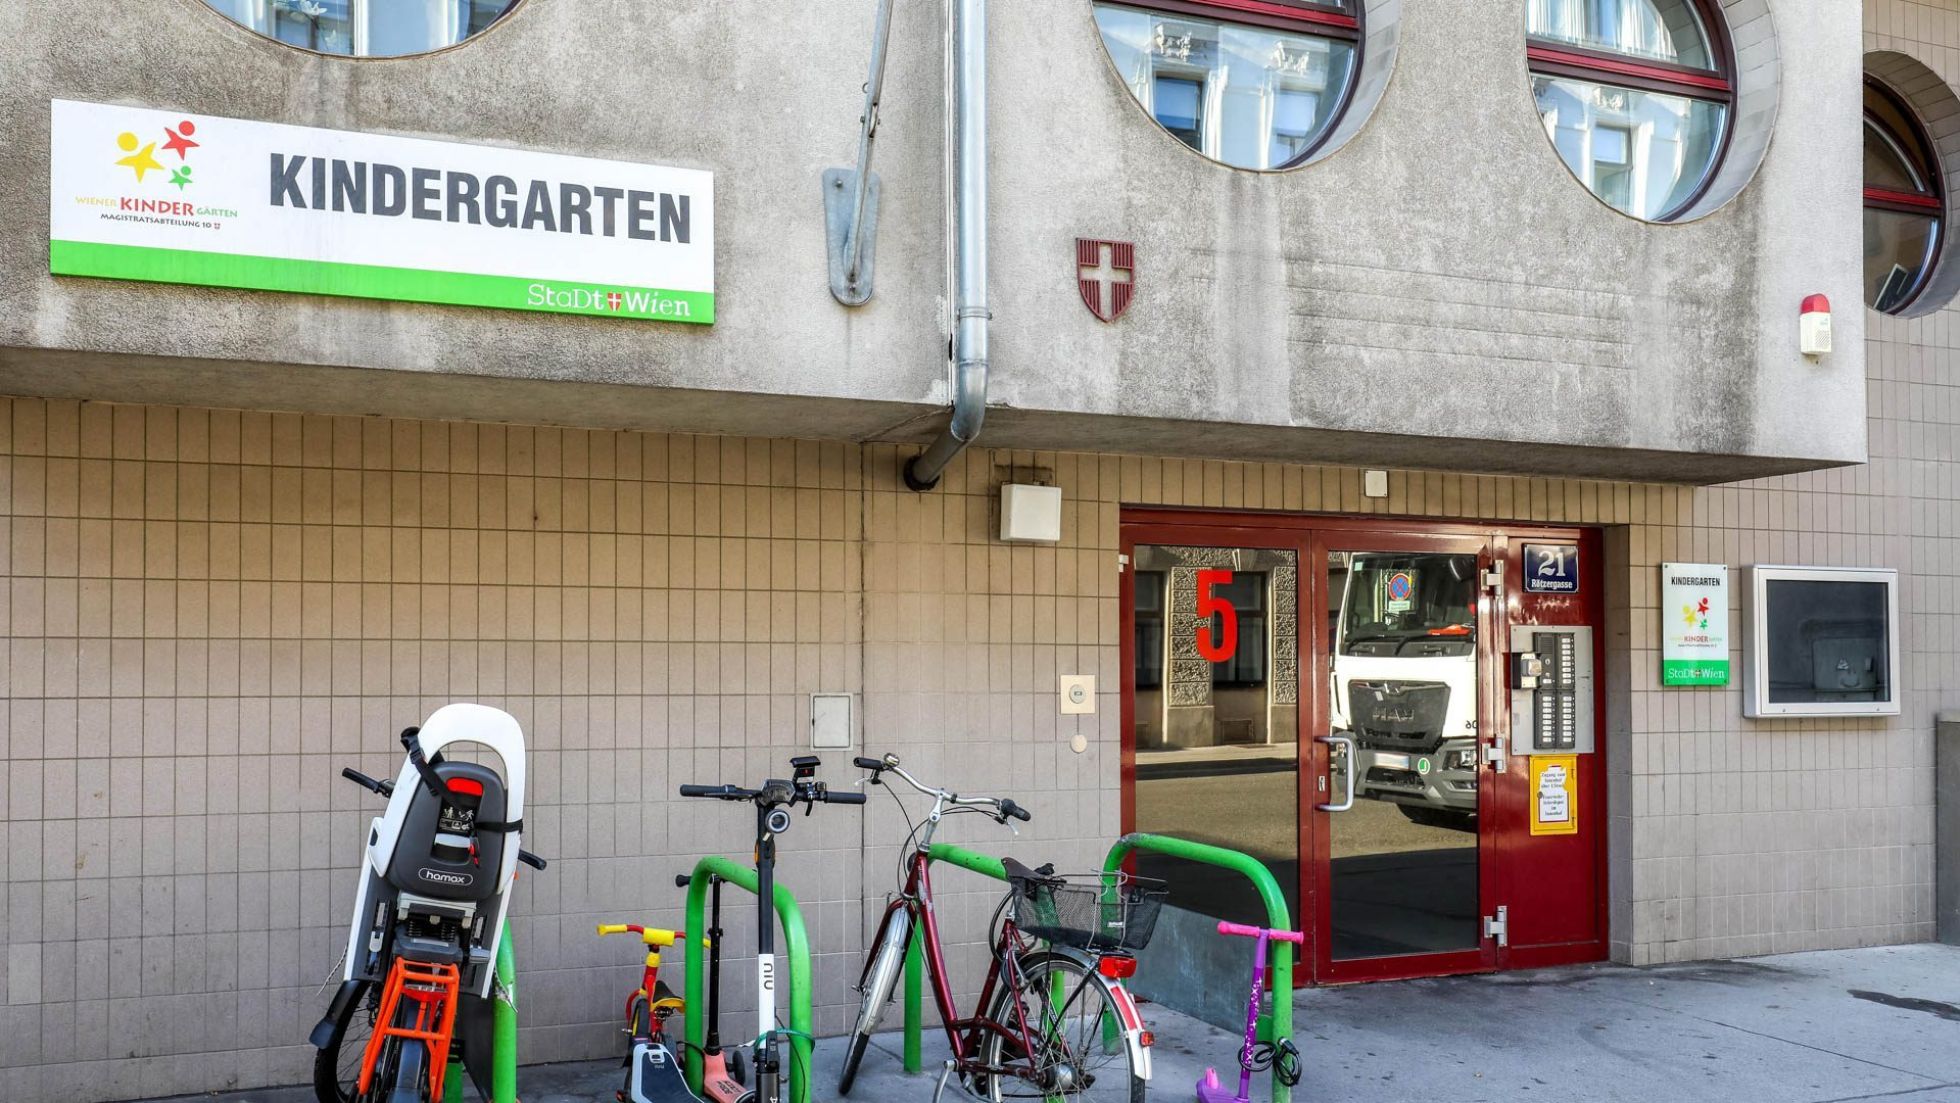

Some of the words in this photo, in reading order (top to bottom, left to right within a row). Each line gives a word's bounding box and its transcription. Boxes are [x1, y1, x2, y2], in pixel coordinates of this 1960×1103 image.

[75, 196, 117, 208] WIENER
[120, 196, 194, 217] KINDER
[270, 152, 691, 244] KINDERGARTEN
[100, 213, 200, 228] MAGISTRATSABTEILUNG
[624, 290, 691, 316] Wien
[1538, 550, 1566, 577] 21
[1531, 578, 1573, 590] Rötzergasse
[1671, 576, 1721, 586] KINDERGARTEN
[1196, 569, 1238, 663] 5
[1701, 669, 1725, 679] Wien
[426, 870, 466, 884] hamax
